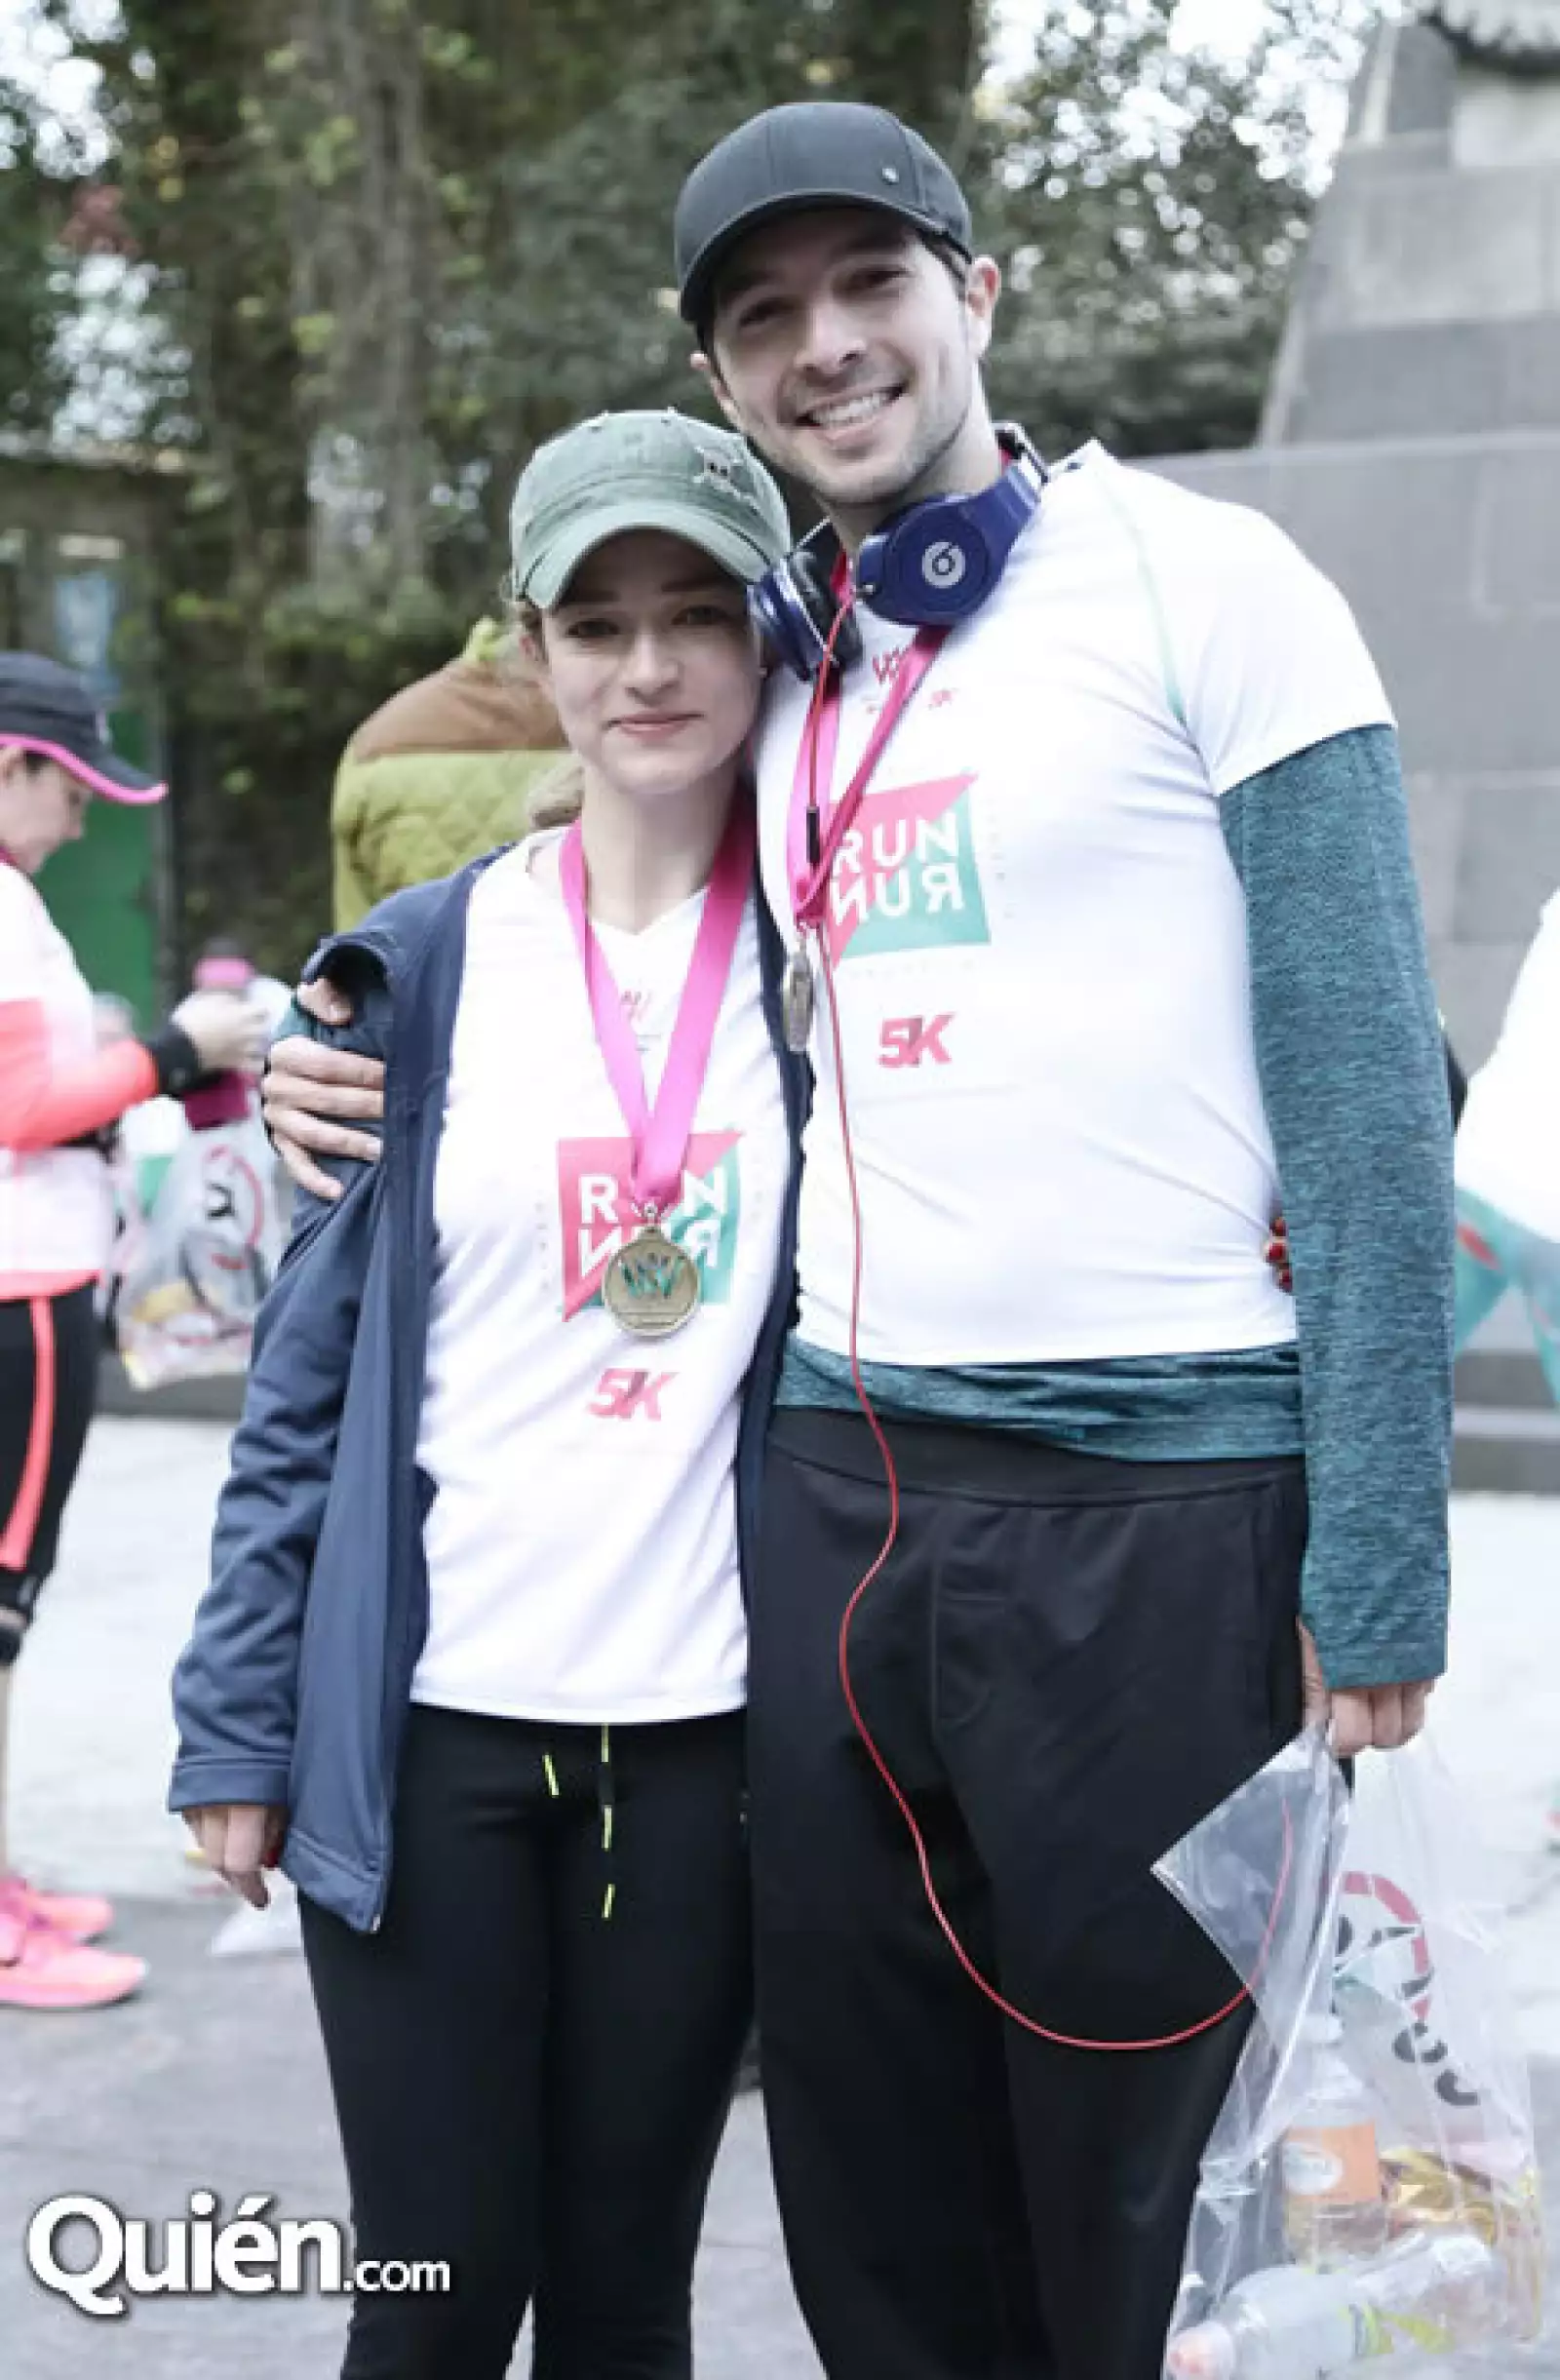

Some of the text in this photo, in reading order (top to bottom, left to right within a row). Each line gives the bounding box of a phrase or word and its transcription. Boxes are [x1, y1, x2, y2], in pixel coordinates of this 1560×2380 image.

[833, 813, 958, 877] RUN
[878, 1012, 956, 1068] 5K
[579, 1167, 724, 1224] RN
[587, 1367, 680, 1421] 5K
